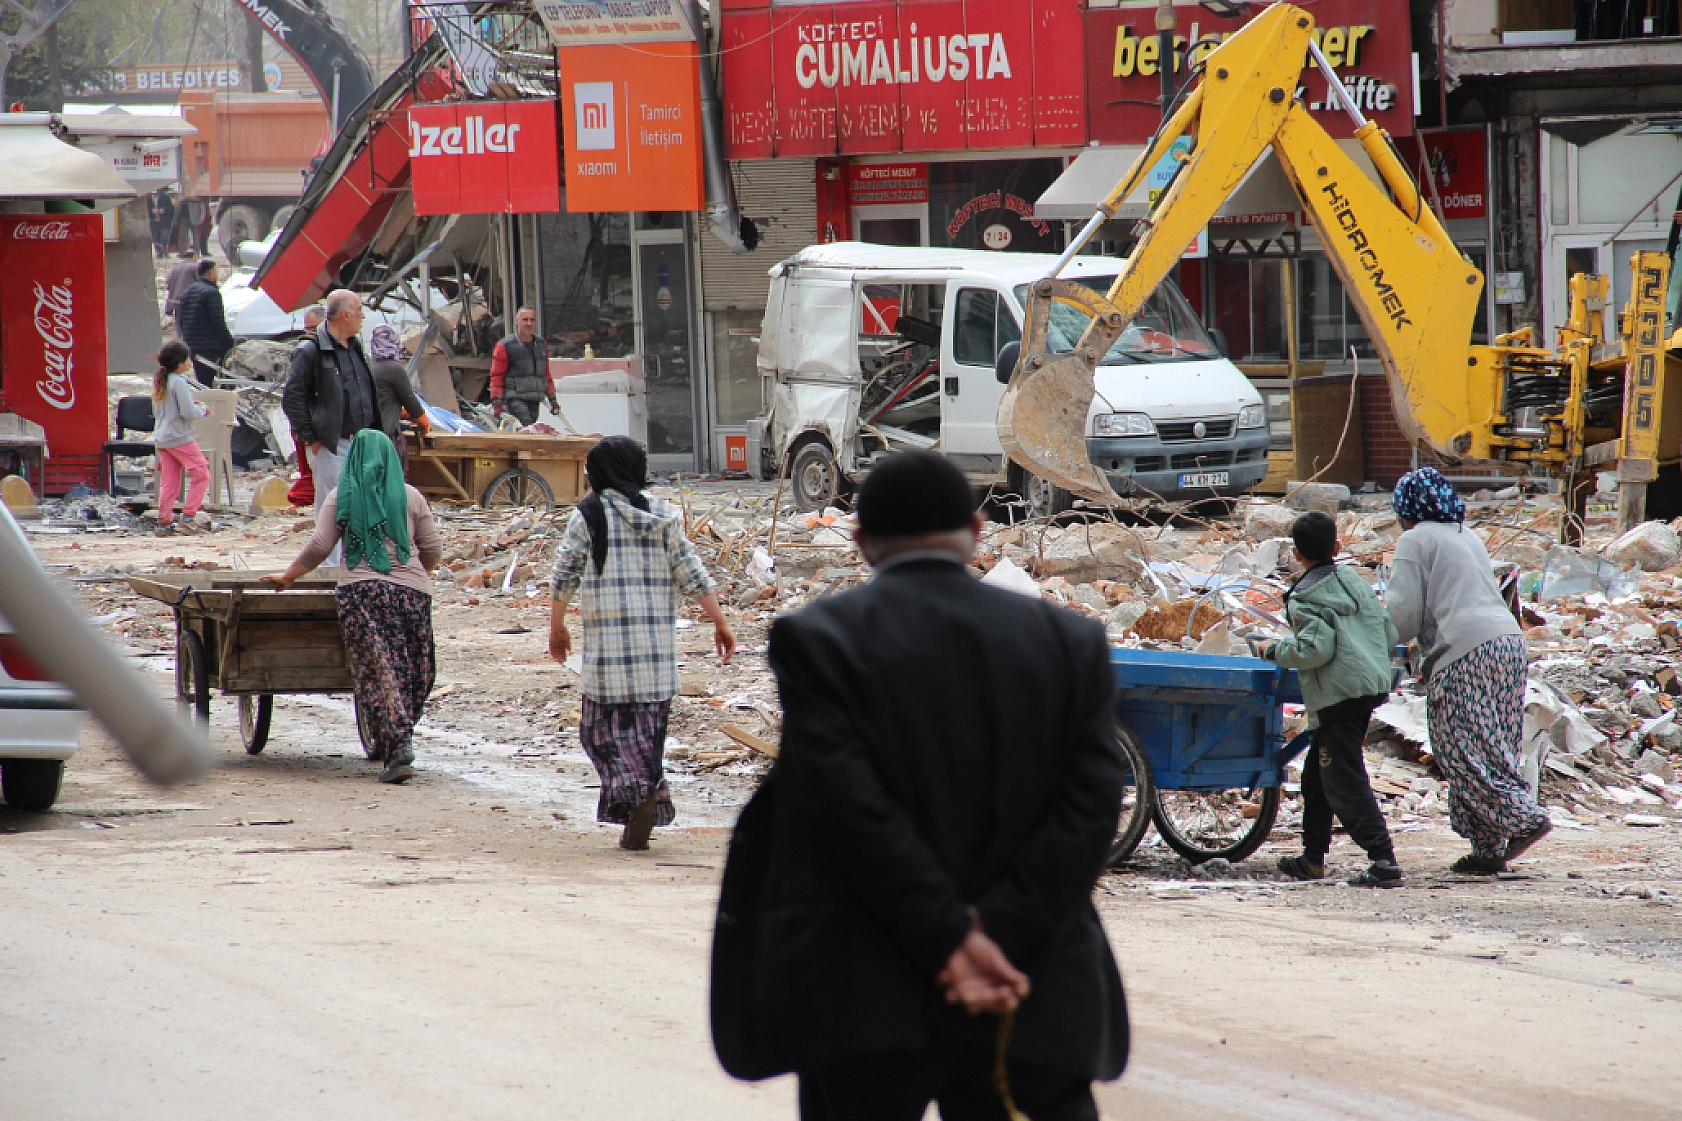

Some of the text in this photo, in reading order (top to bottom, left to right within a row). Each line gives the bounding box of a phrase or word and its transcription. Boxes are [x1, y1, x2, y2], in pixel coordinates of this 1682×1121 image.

[242, 0, 292, 40] MEK
[136, 67, 241, 89] BELEDİYES
[639, 103, 682, 120] Tamirci
[640, 125, 683, 151] İletişim
[892, 167, 917, 178] MESUT
[1444, 192, 1484, 209] DÖNER
[947, 189, 1001, 239] KÖFTECİ
[13, 221, 72, 240] Coca-Cola
[1322, 181, 1413, 333] HİDROMEK
[33, 279, 76, 410] Coca-Cola
